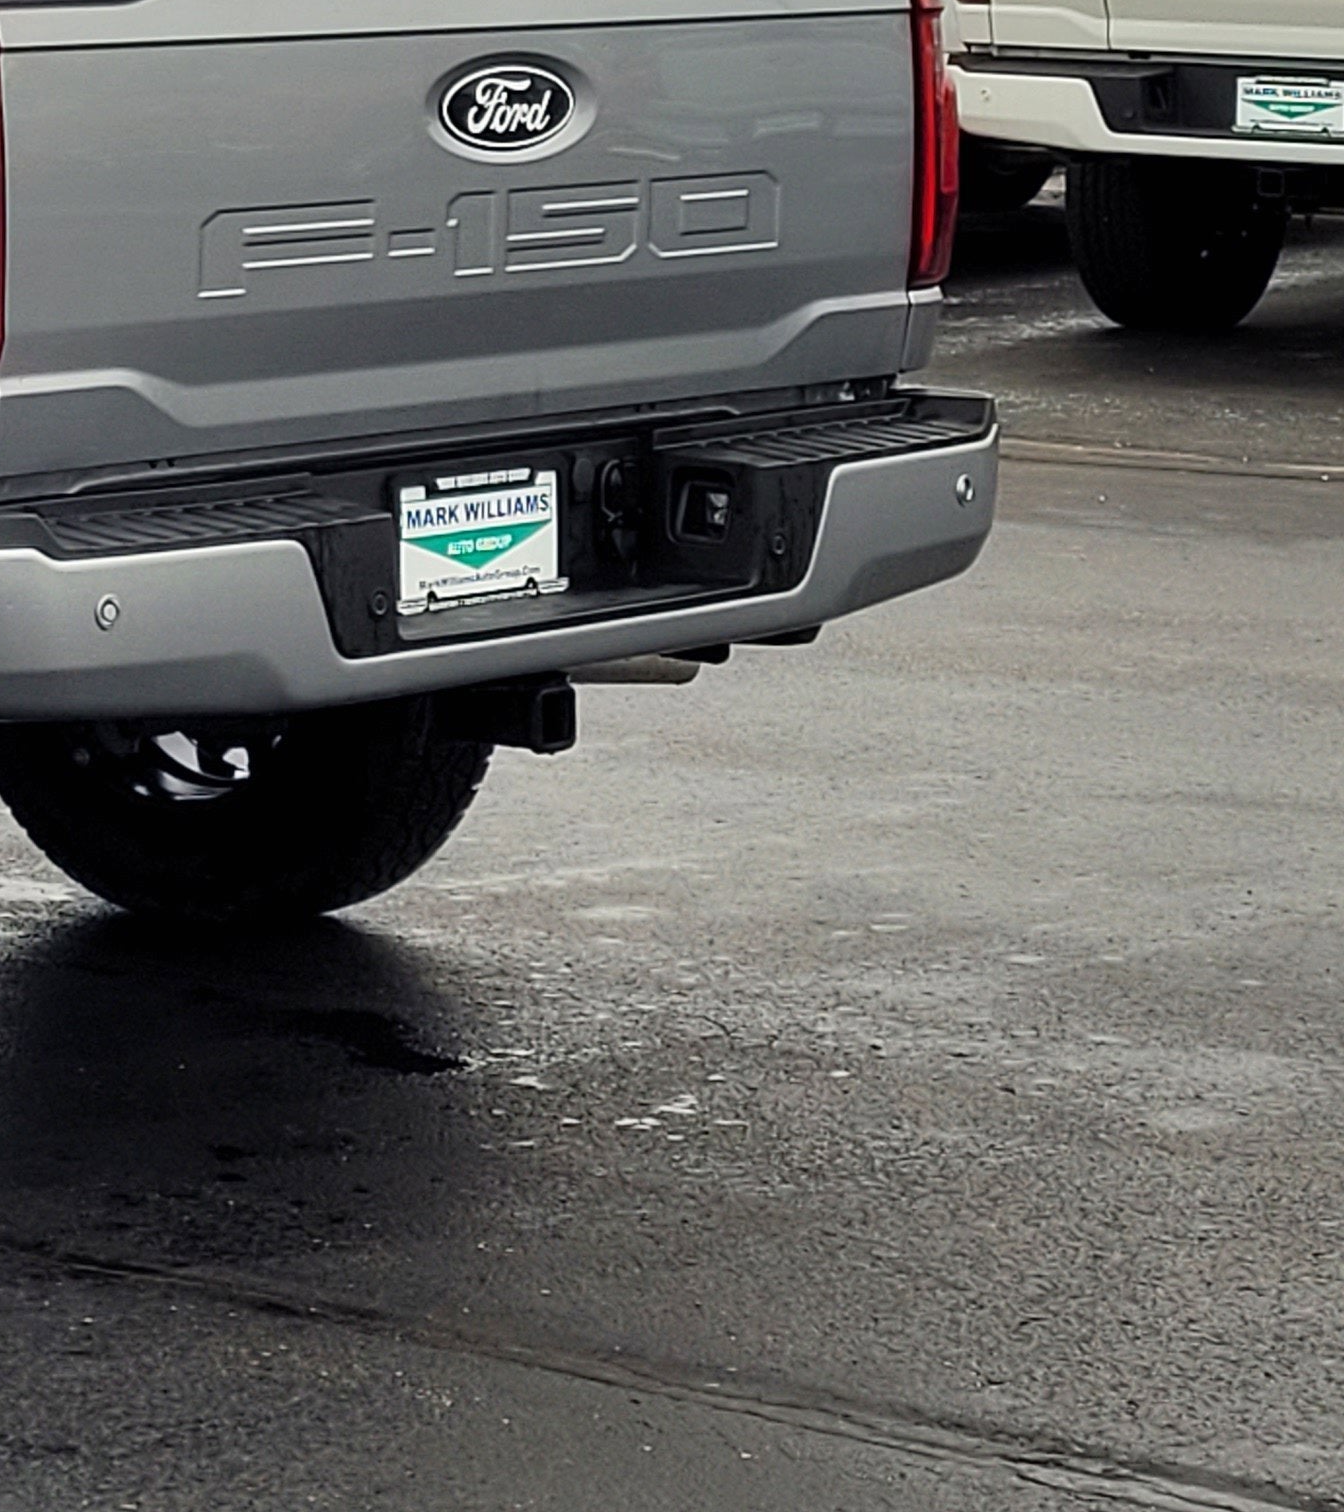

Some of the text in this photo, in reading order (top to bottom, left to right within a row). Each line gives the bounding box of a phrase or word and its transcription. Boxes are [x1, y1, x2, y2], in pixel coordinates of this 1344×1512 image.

[466, 76, 552, 134] Ford
[197, 169, 781, 299] F-150
[406, 493, 550, 530] MARK WILLIAMS
